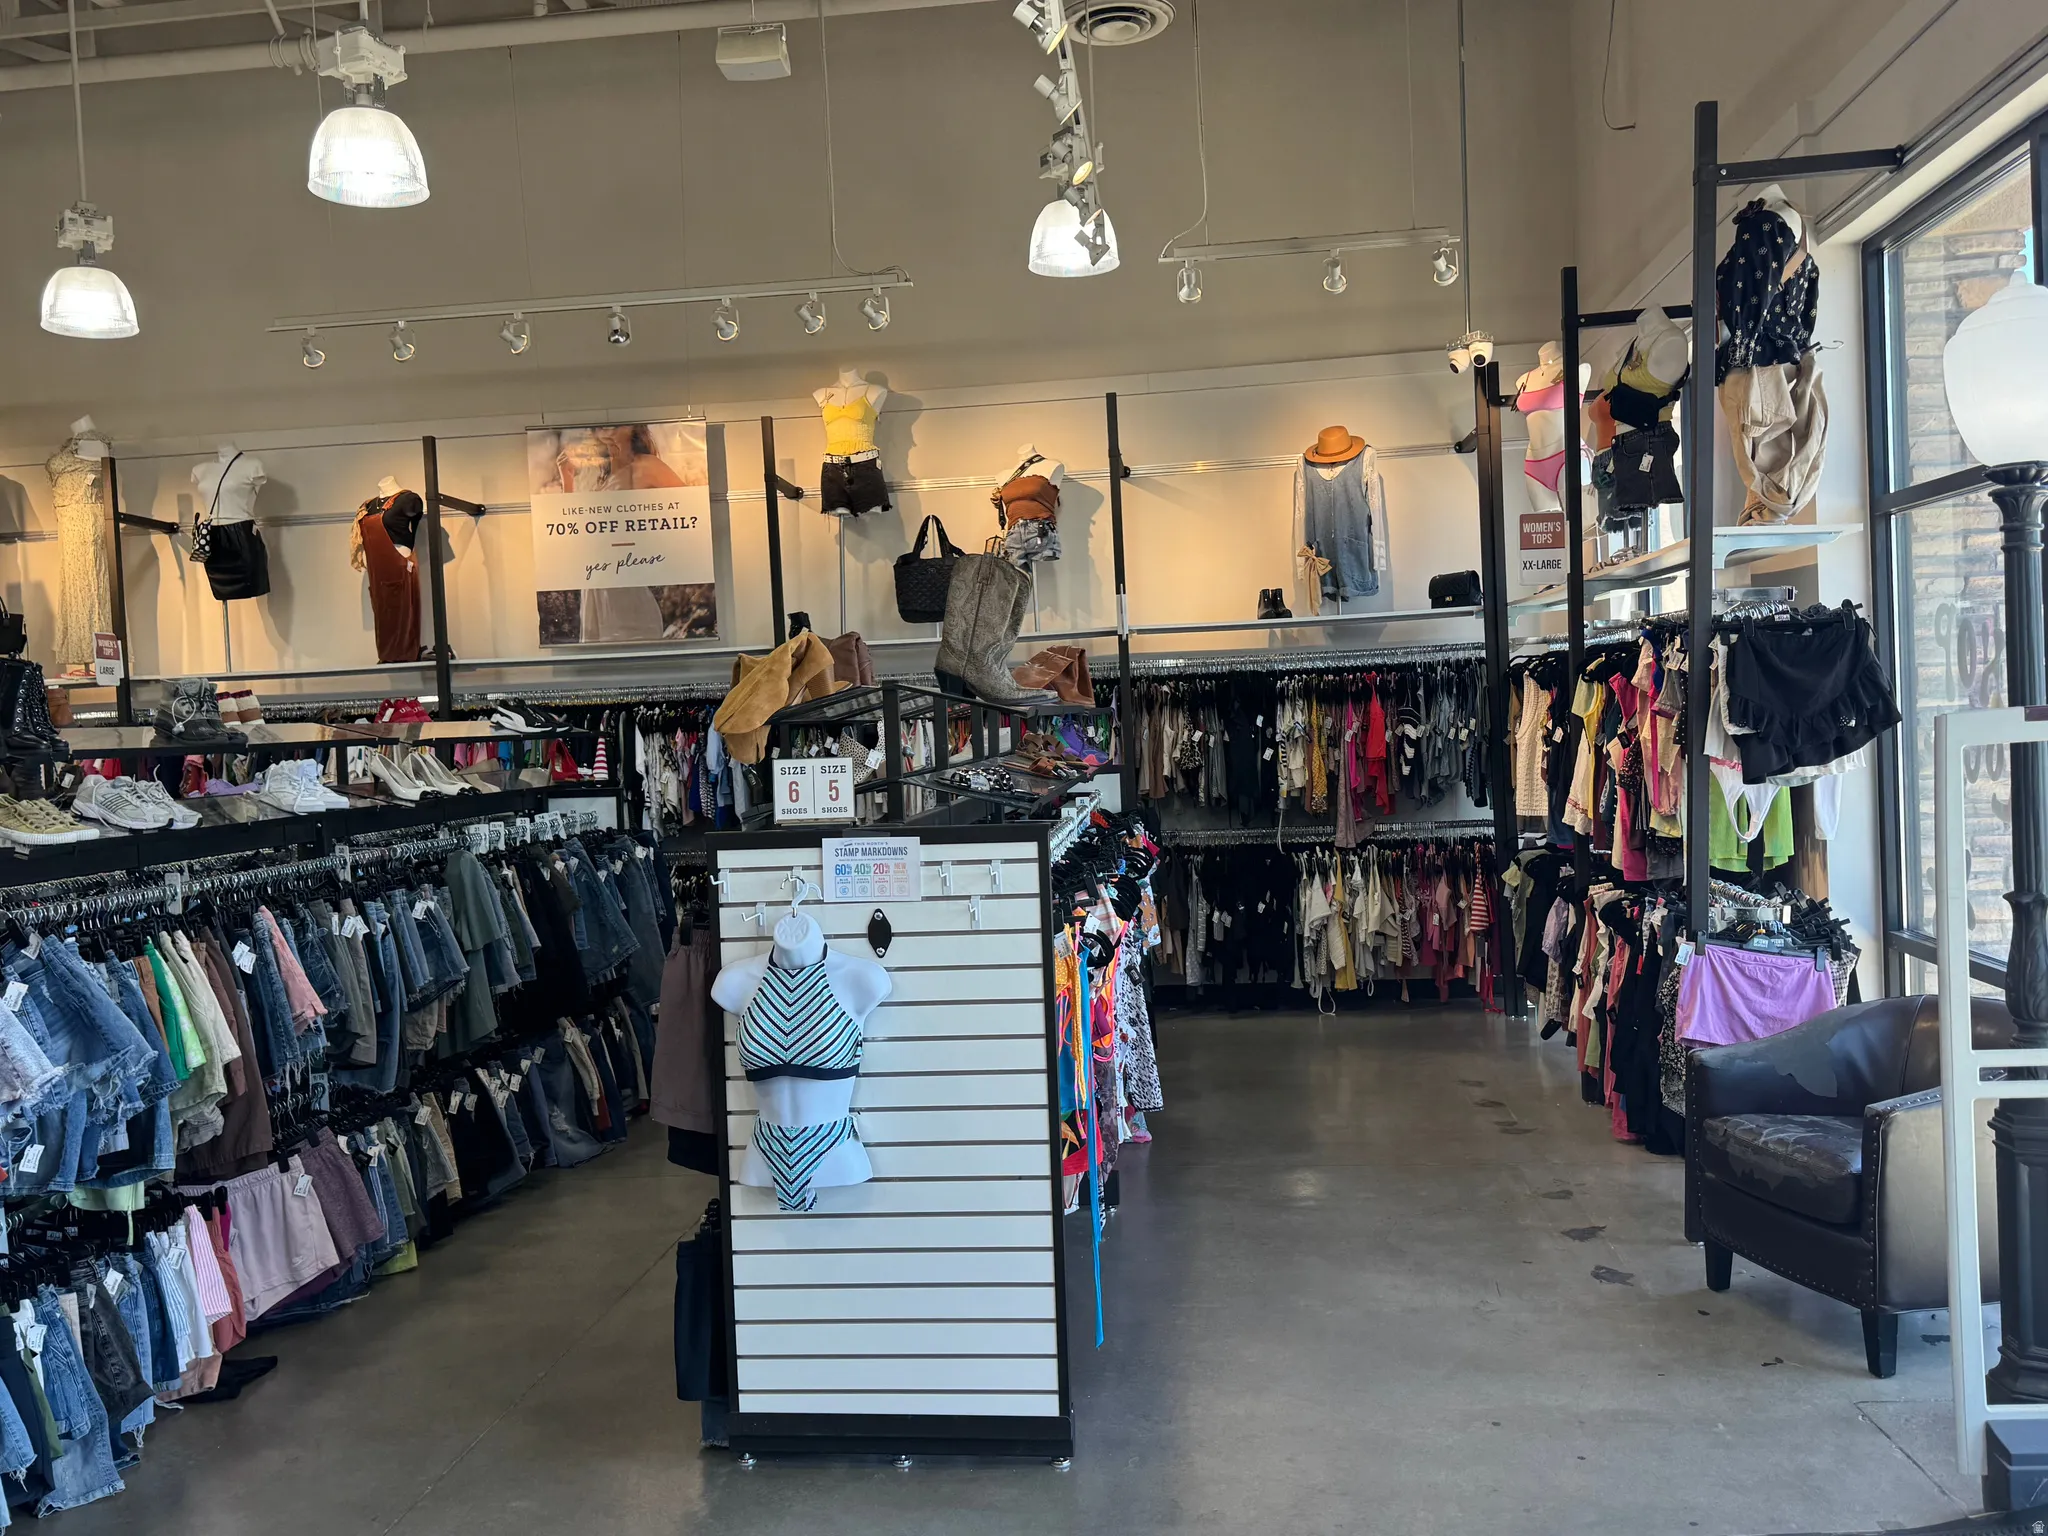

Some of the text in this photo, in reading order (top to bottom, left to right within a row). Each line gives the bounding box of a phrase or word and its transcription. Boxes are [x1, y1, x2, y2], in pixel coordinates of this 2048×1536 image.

[562, 501, 680, 516] LIKE-NEW CLOTHES AT
[546, 516, 698, 536] 70% OFF RETAIL?
[1523, 522, 1561, 533] WOMEN'S
[1531, 533, 1553, 544] TOPS
[585, 551, 666, 581] yes please
[1522, 558, 1562, 571] XX-LARGE
[99, 666, 115, 676] LARGE
[780, 766, 806, 775] SIZE
[820, 764, 847, 774] SIZE
[788, 780, 800, 803] 6
[828, 779, 840, 802] 5
[781, 807, 808, 815] SHOES
[821, 806, 848, 814] SHOES
[834, 846, 908, 858] STAMP MARKDOWNS
